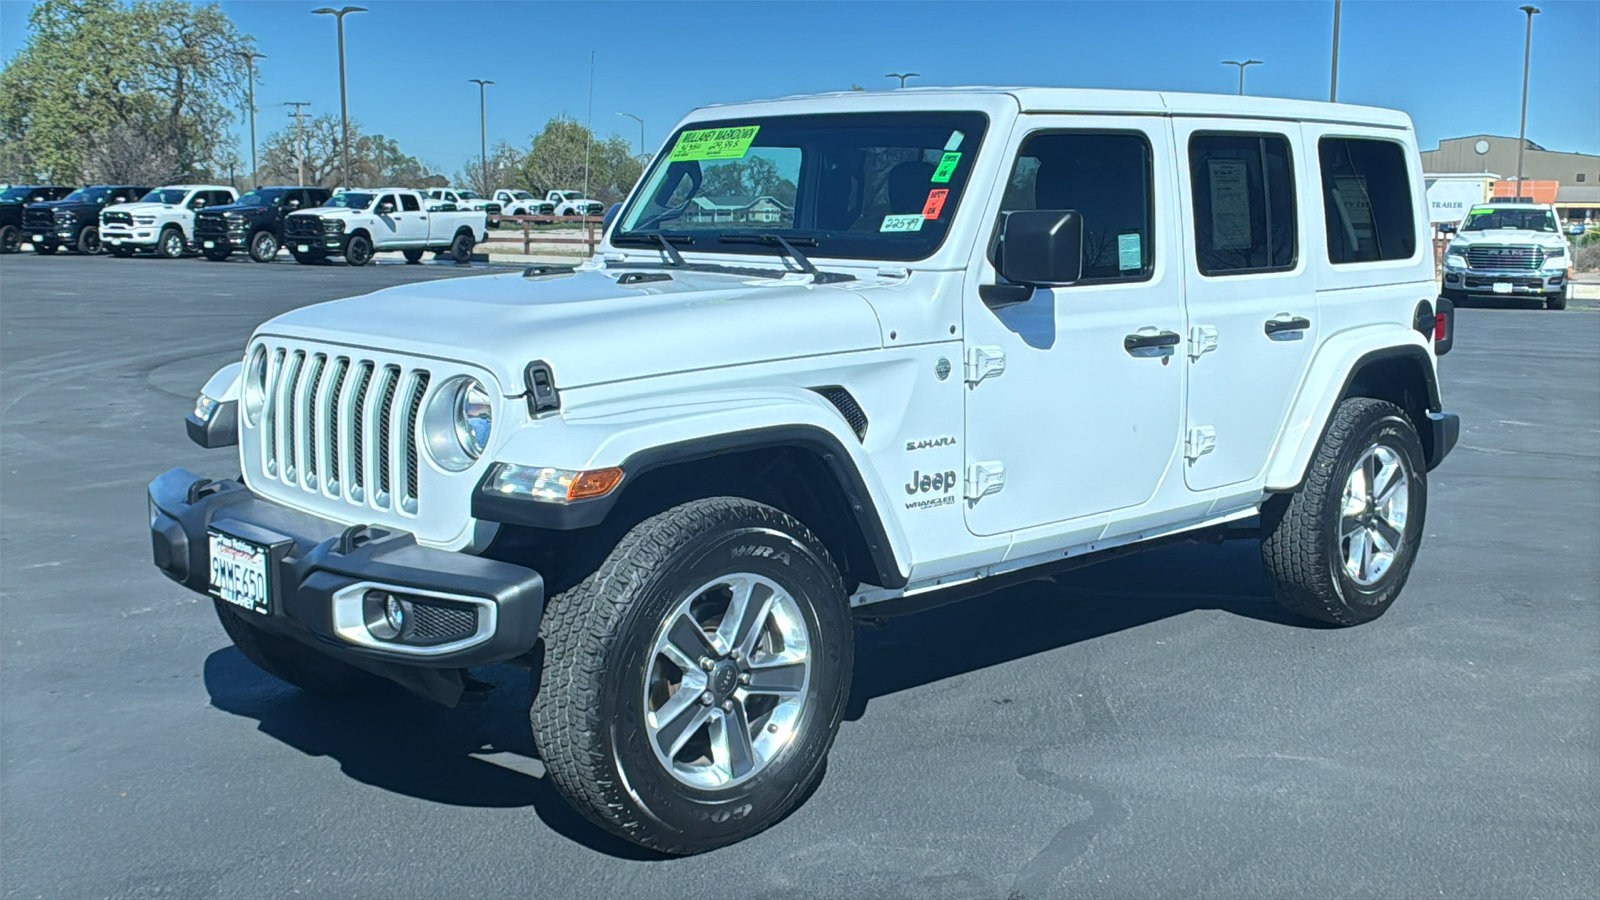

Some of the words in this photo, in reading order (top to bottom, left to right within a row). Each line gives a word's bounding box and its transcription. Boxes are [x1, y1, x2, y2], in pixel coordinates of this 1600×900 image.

[1432, 201, 1463, 209] TRAILER
[906, 437, 956, 450] SAHARA
[905, 470, 956, 495] Jeep
[905, 496, 955, 509] WRANGLER
